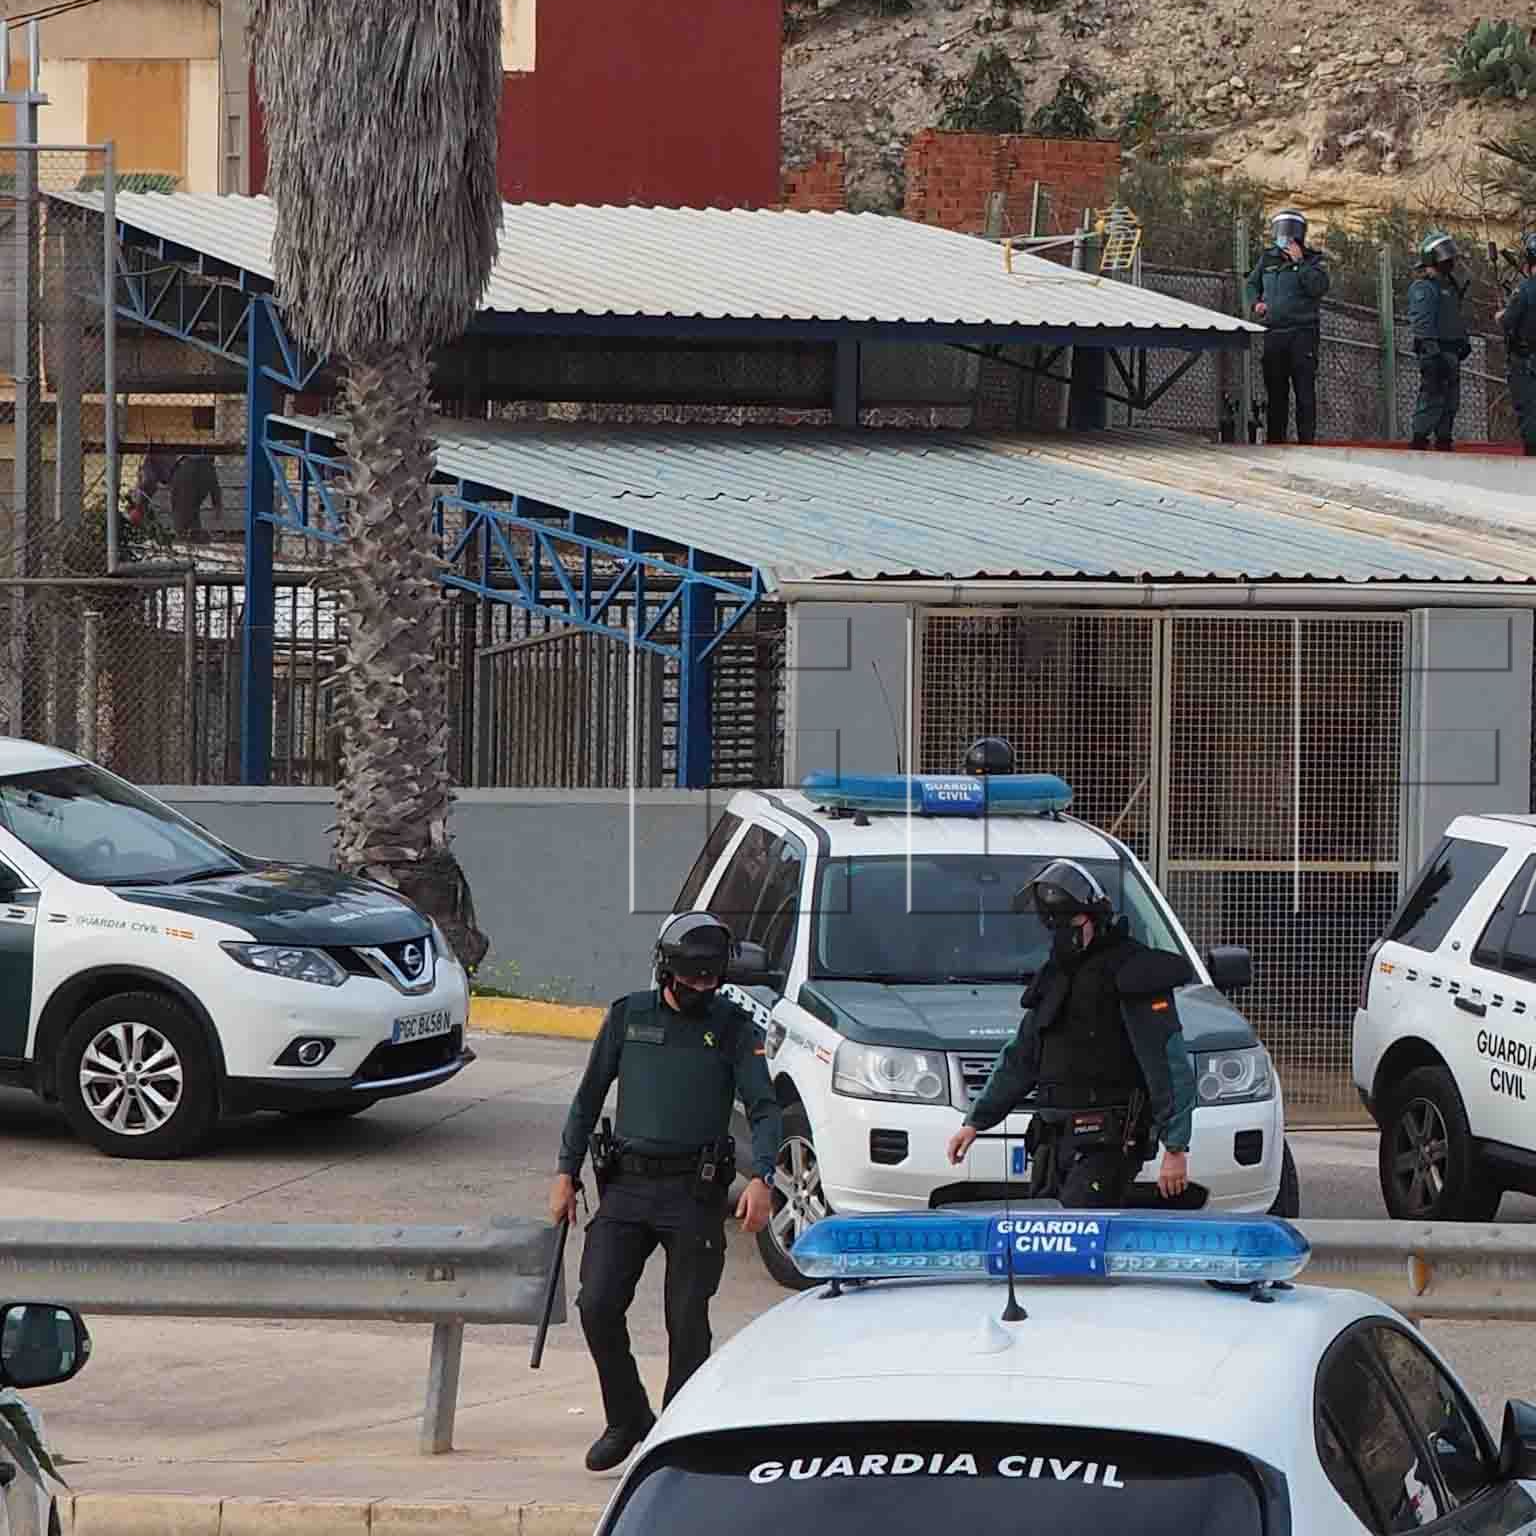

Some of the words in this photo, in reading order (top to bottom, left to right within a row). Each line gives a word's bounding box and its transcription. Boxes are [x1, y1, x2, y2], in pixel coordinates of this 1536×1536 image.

[938, 791, 971, 801] CIVIL
[1490, 1066, 1527, 1101] CIVIL
[997, 1220, 1100, 1235] GUARDIA
[1015, 1235, 1078, 1253] CIVIL
[748, 1452, 979, 1485] GUARDIA
[997, 1455, 1125, 1489] CIVIL
